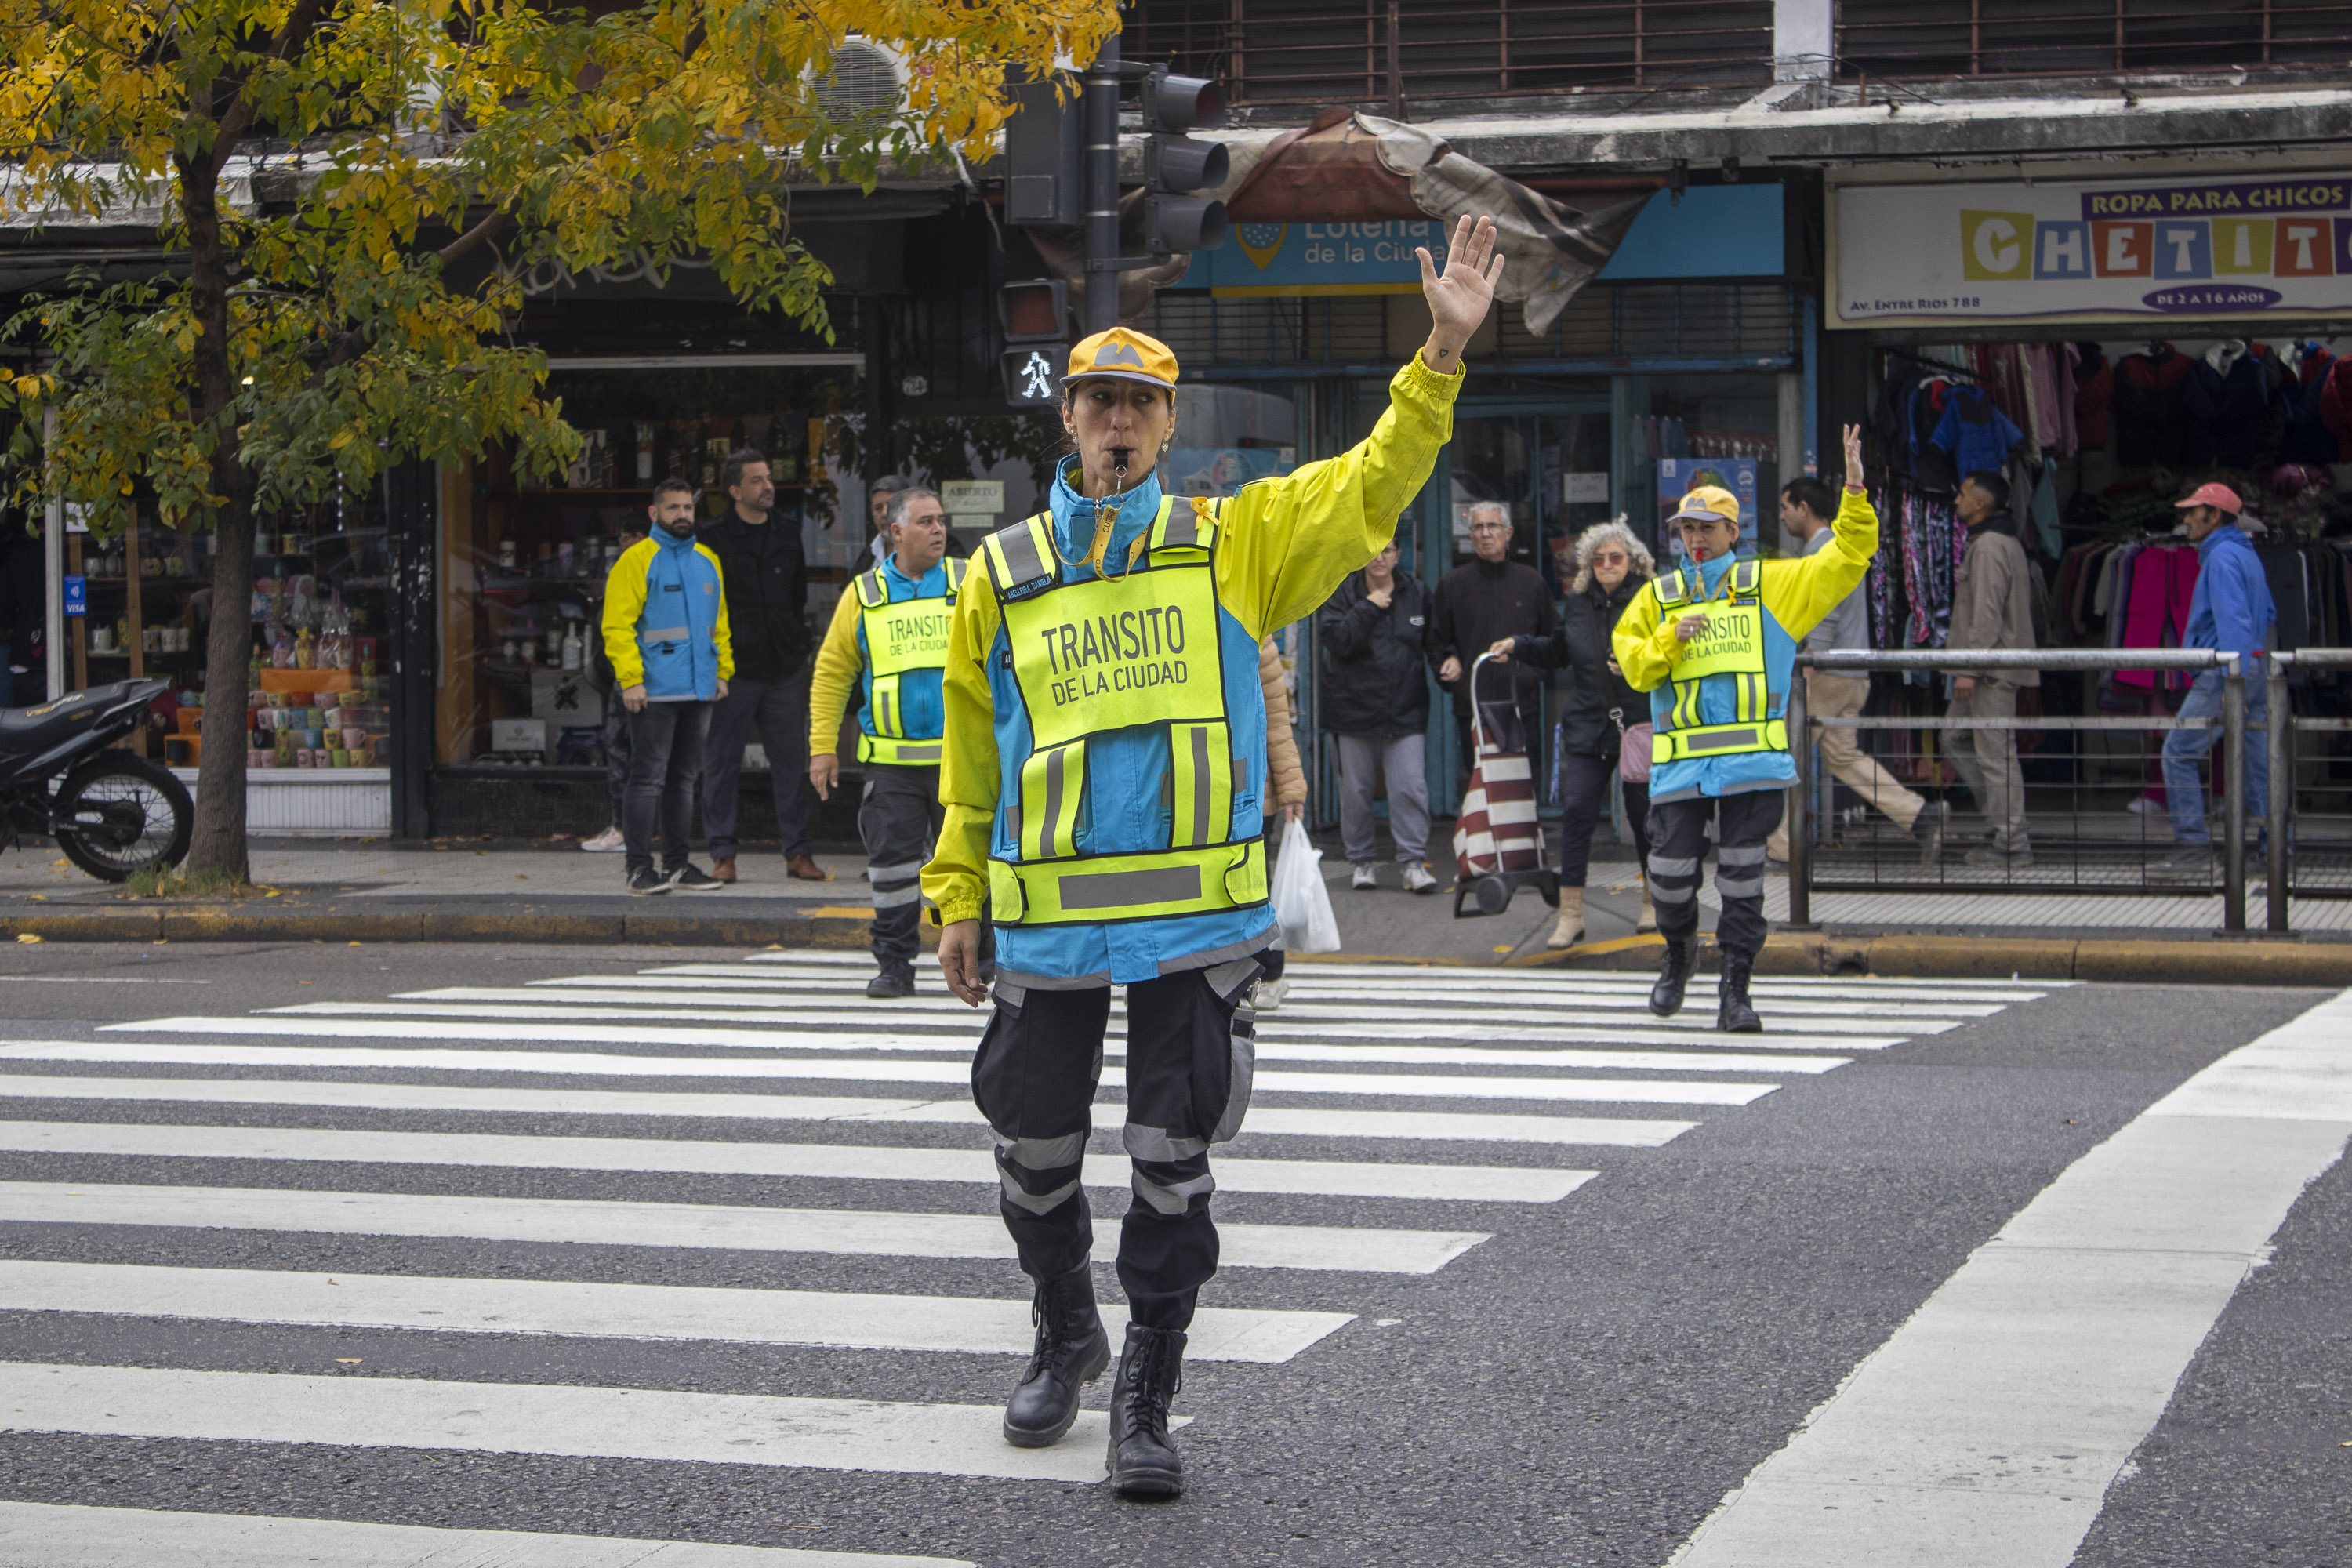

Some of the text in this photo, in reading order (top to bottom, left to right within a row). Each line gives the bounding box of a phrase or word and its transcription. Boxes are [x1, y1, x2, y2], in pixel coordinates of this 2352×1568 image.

[2092, 185, 2343, 214] ROPA PARA CHICOS
[1305, 240, 1446, 263] de la Ciua
[1973, 216, 2352, 274] CHETIT
[1874, 299, 1914, 310] ENTRE
[1917, 298, 1949, 309] RIOS
[1953, 296, 1980, 307] 788
[2157, 290, 2266, 305] DE 2 A 16 AÑOS
[1102, 508, 1116, 533] CUERP
[67, 604, 85, 613] VISA
[1041, 604, 1185, 675] TRANSITO
[1687, 614, 1751, 645] ANSITO
[890, 639, 948, 656] DE LA CIUDA
[1681, 641, 1751, 662] DE LA CIUDAD
[1051, 660, 1188, 706] DE LA CIUDAD
